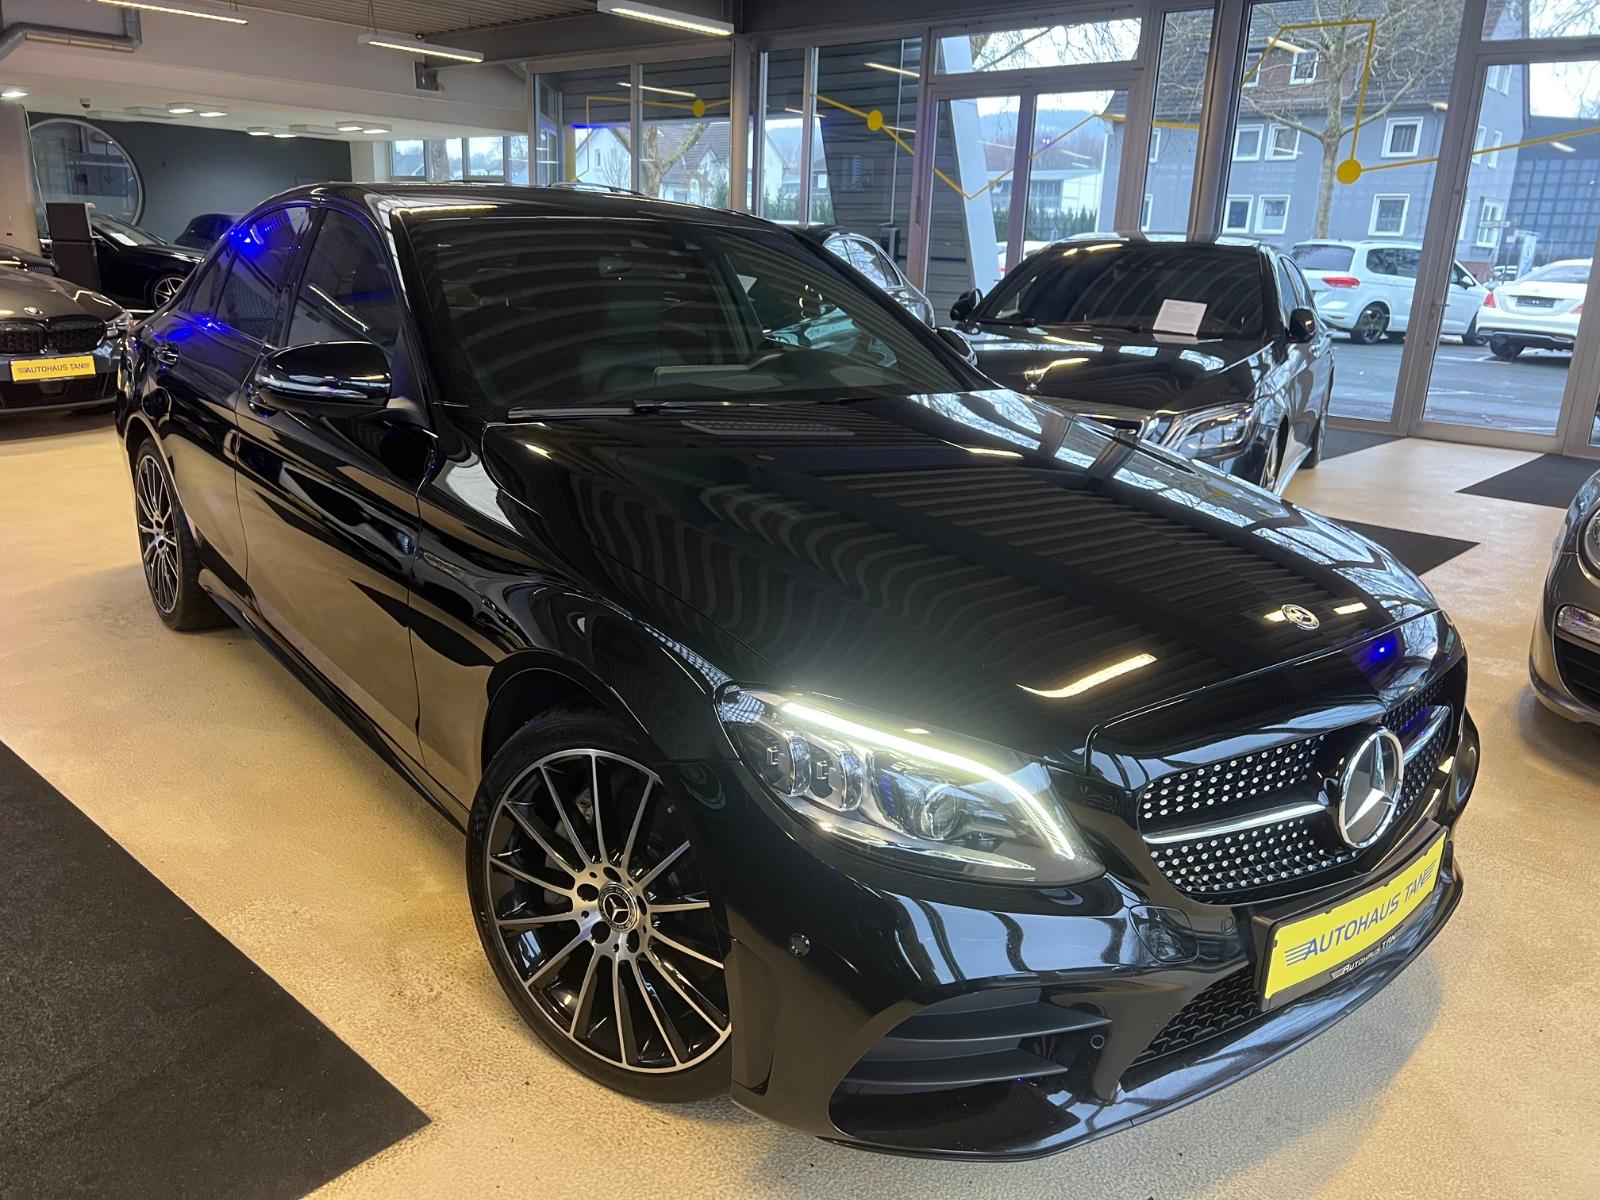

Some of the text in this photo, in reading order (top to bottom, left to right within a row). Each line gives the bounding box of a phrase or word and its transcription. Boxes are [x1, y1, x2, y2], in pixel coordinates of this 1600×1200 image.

[25, 364, 68, 373] AUTOHAUS
[1304, 868, 1429, 960] AUTOHAUS TAN
